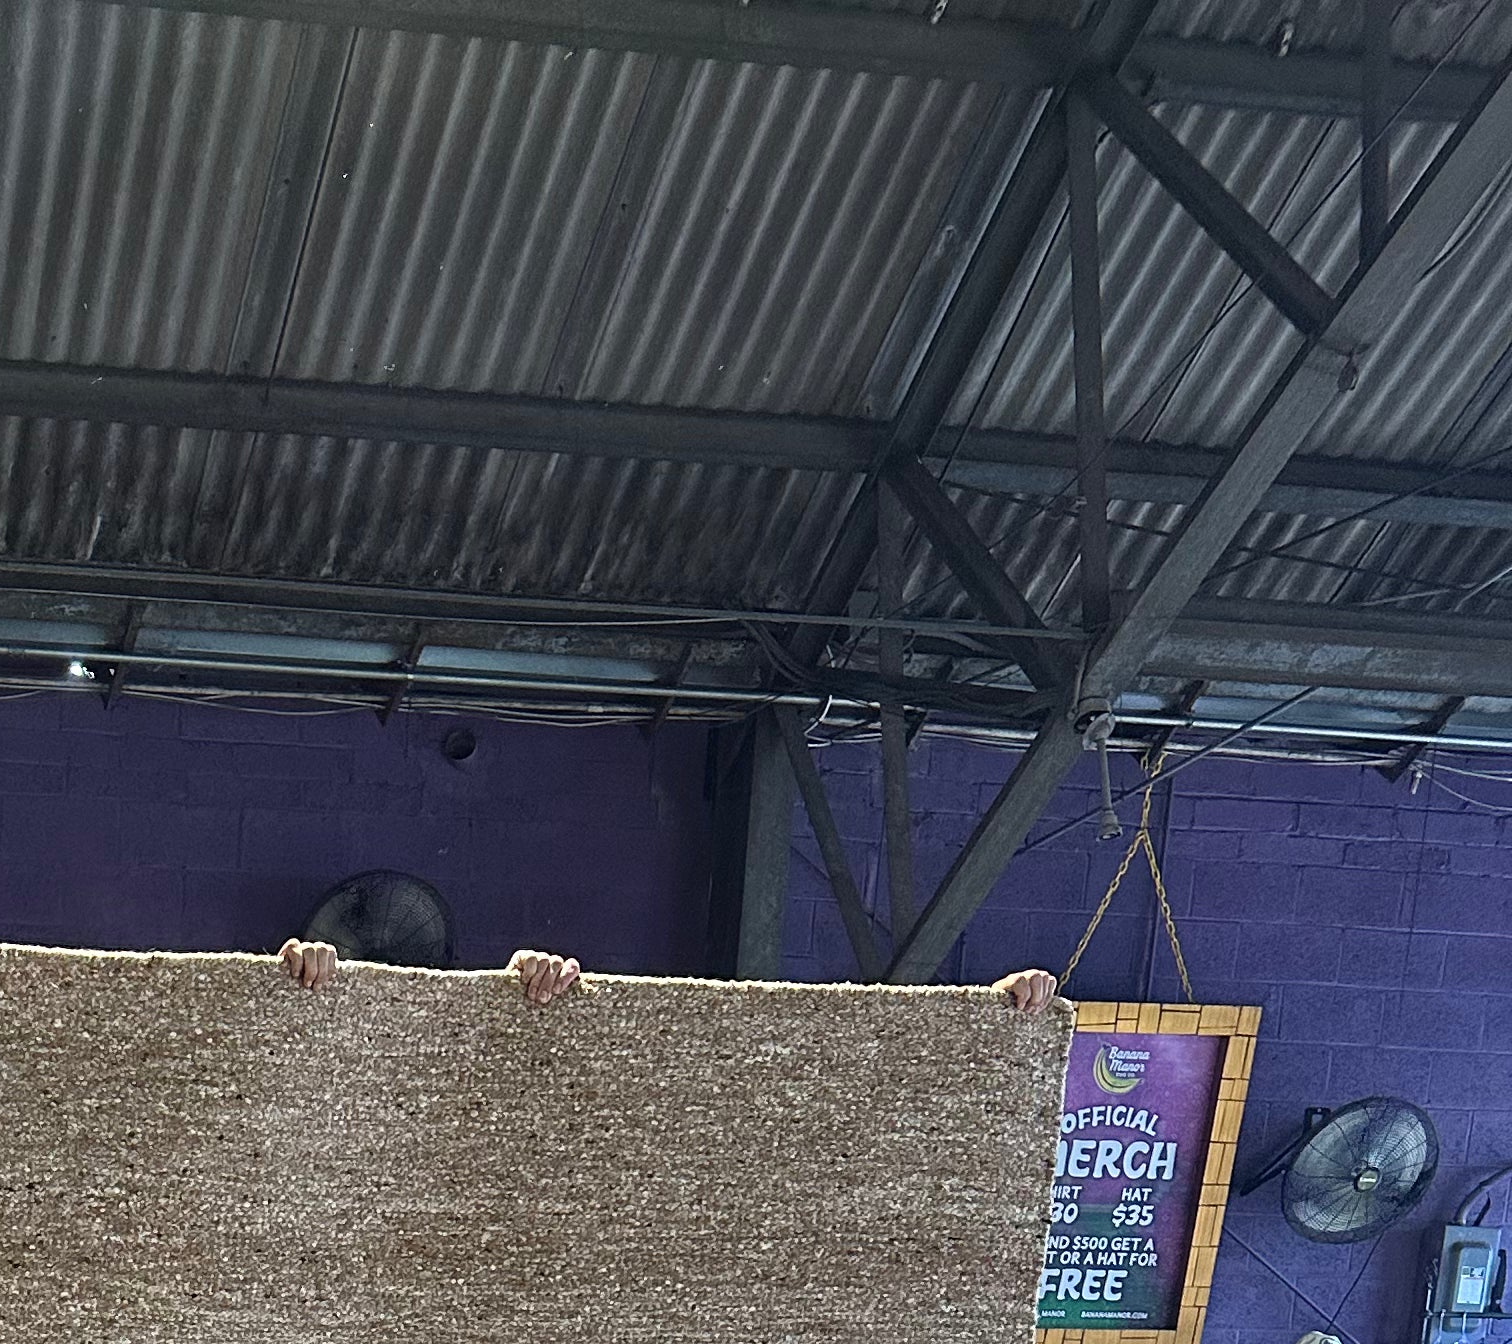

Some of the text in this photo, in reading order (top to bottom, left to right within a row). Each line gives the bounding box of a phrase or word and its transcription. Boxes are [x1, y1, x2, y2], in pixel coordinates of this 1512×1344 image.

[1109, 1046, 1150, 1060] Banana
[1109, 1059, 1145, 1072] Manor
[1060, 1105, 1159, 1136] OFFICIAL
[1121, 1187, 1152, 1202] HAT
[1111, 1203, 1154, 1228] $35
[1072, 1236, 1108, 1250] $500
[1111, 1237, 1142, 1251] GET
[1143, 1238, 1154, 1251] A
[1060, 1251, 1080, 1265] OR
[1083, 1252, 1094, 1265] A
[1097, 1252, 1128, 1265] HAT
[1129, 1253, 1158, 1266] FOR
[1038, 1268, 1128, 1301] FREE
